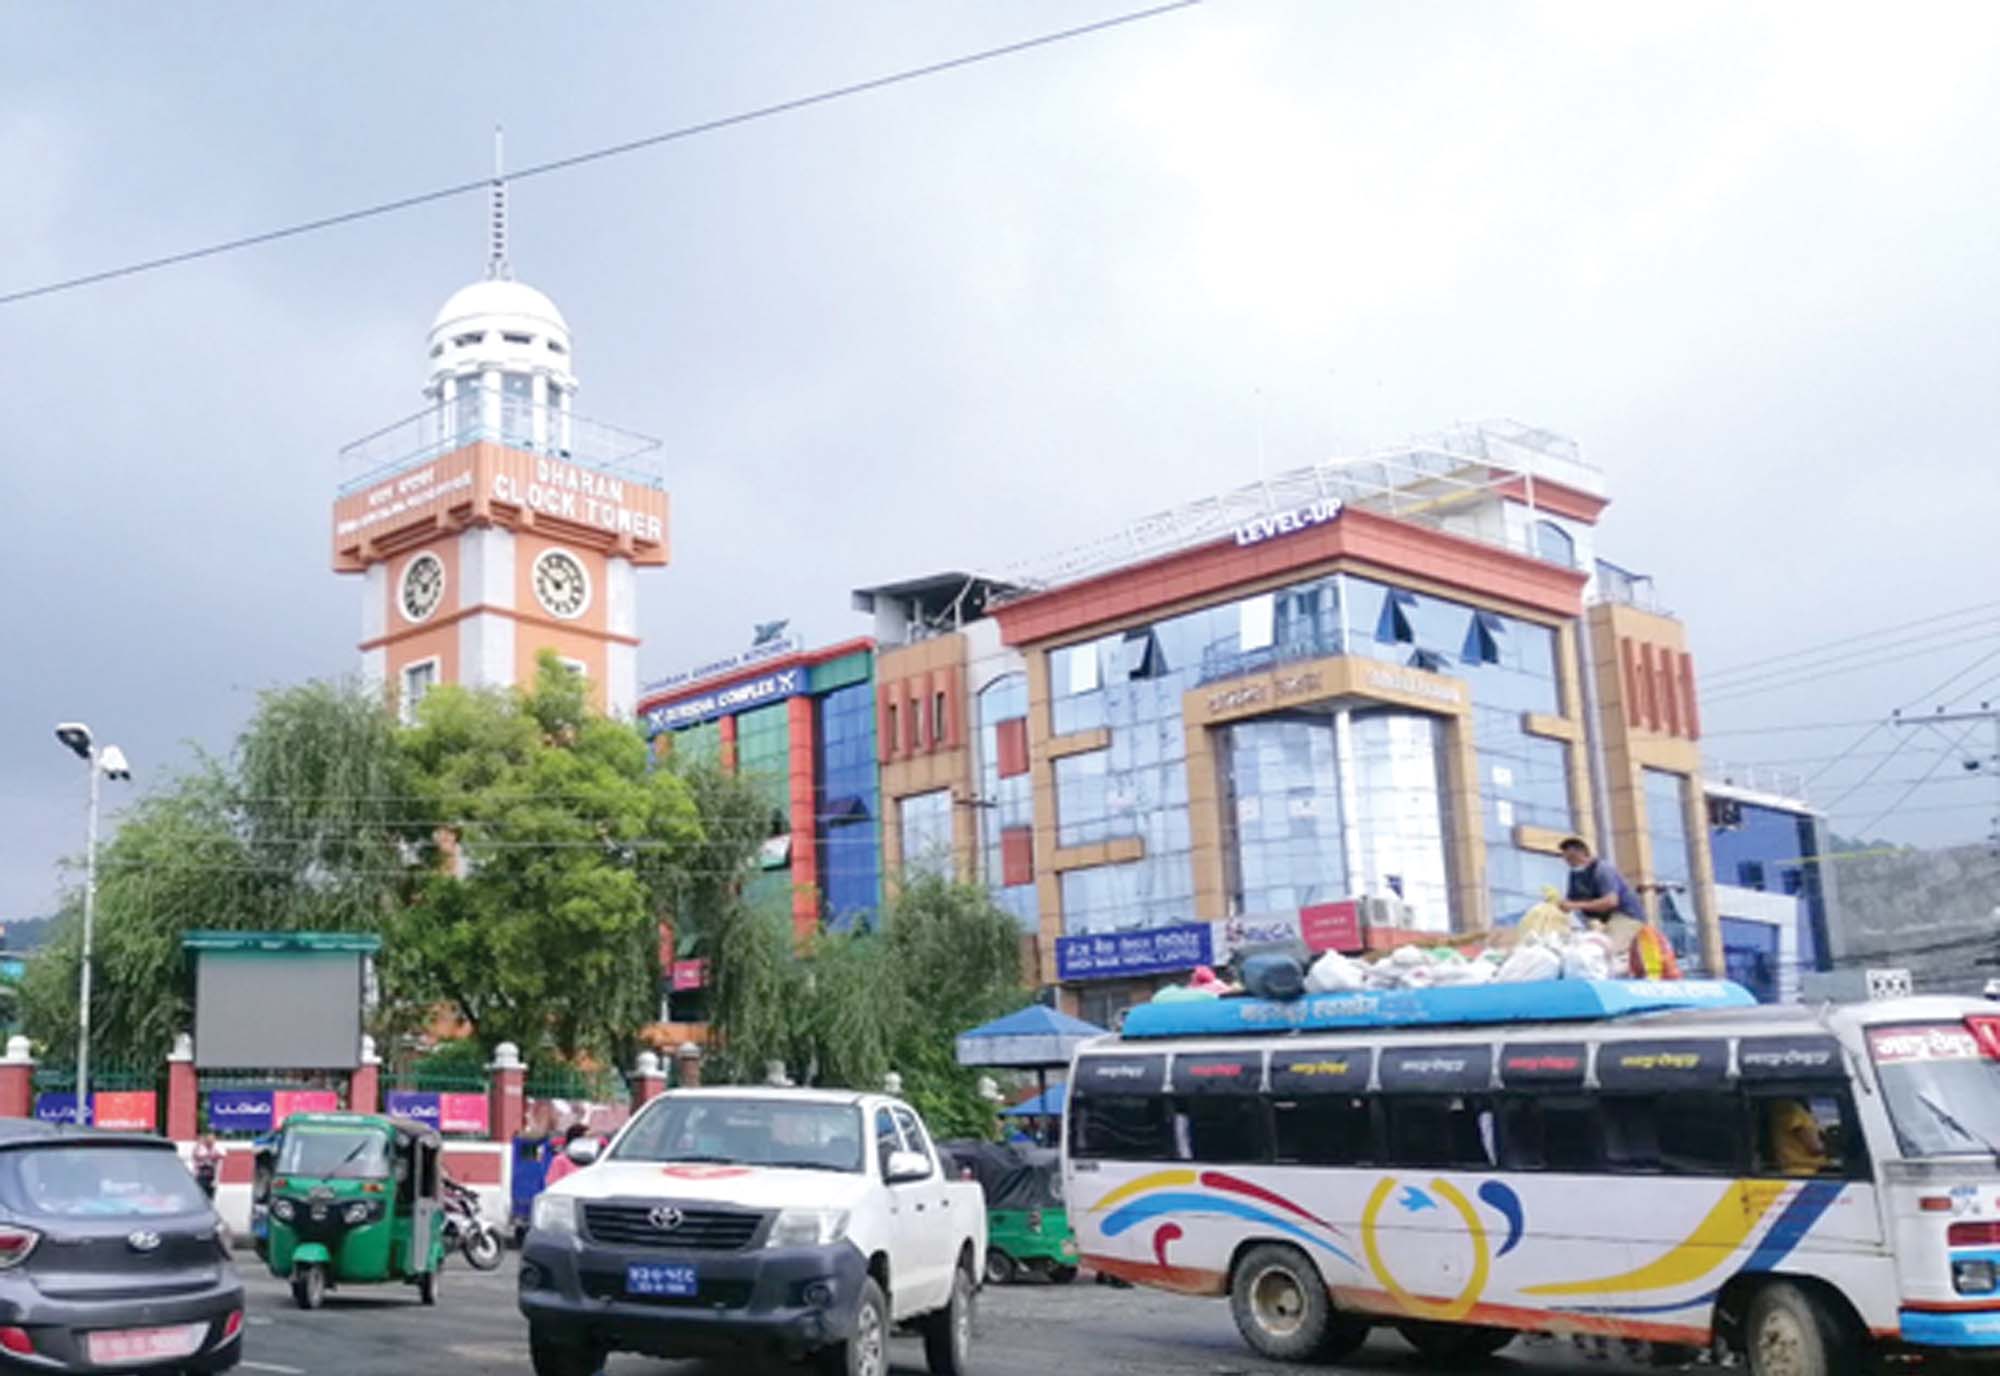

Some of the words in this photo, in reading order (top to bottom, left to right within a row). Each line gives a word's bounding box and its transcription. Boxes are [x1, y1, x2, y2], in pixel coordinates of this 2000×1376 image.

[537, 459, 624, 502] DHARAN
[494, 473, 576, 517] CLOCK
[585, 499, 662, 539] TOWER
[1233, 498, 1342, 545] LEVEL-UP
